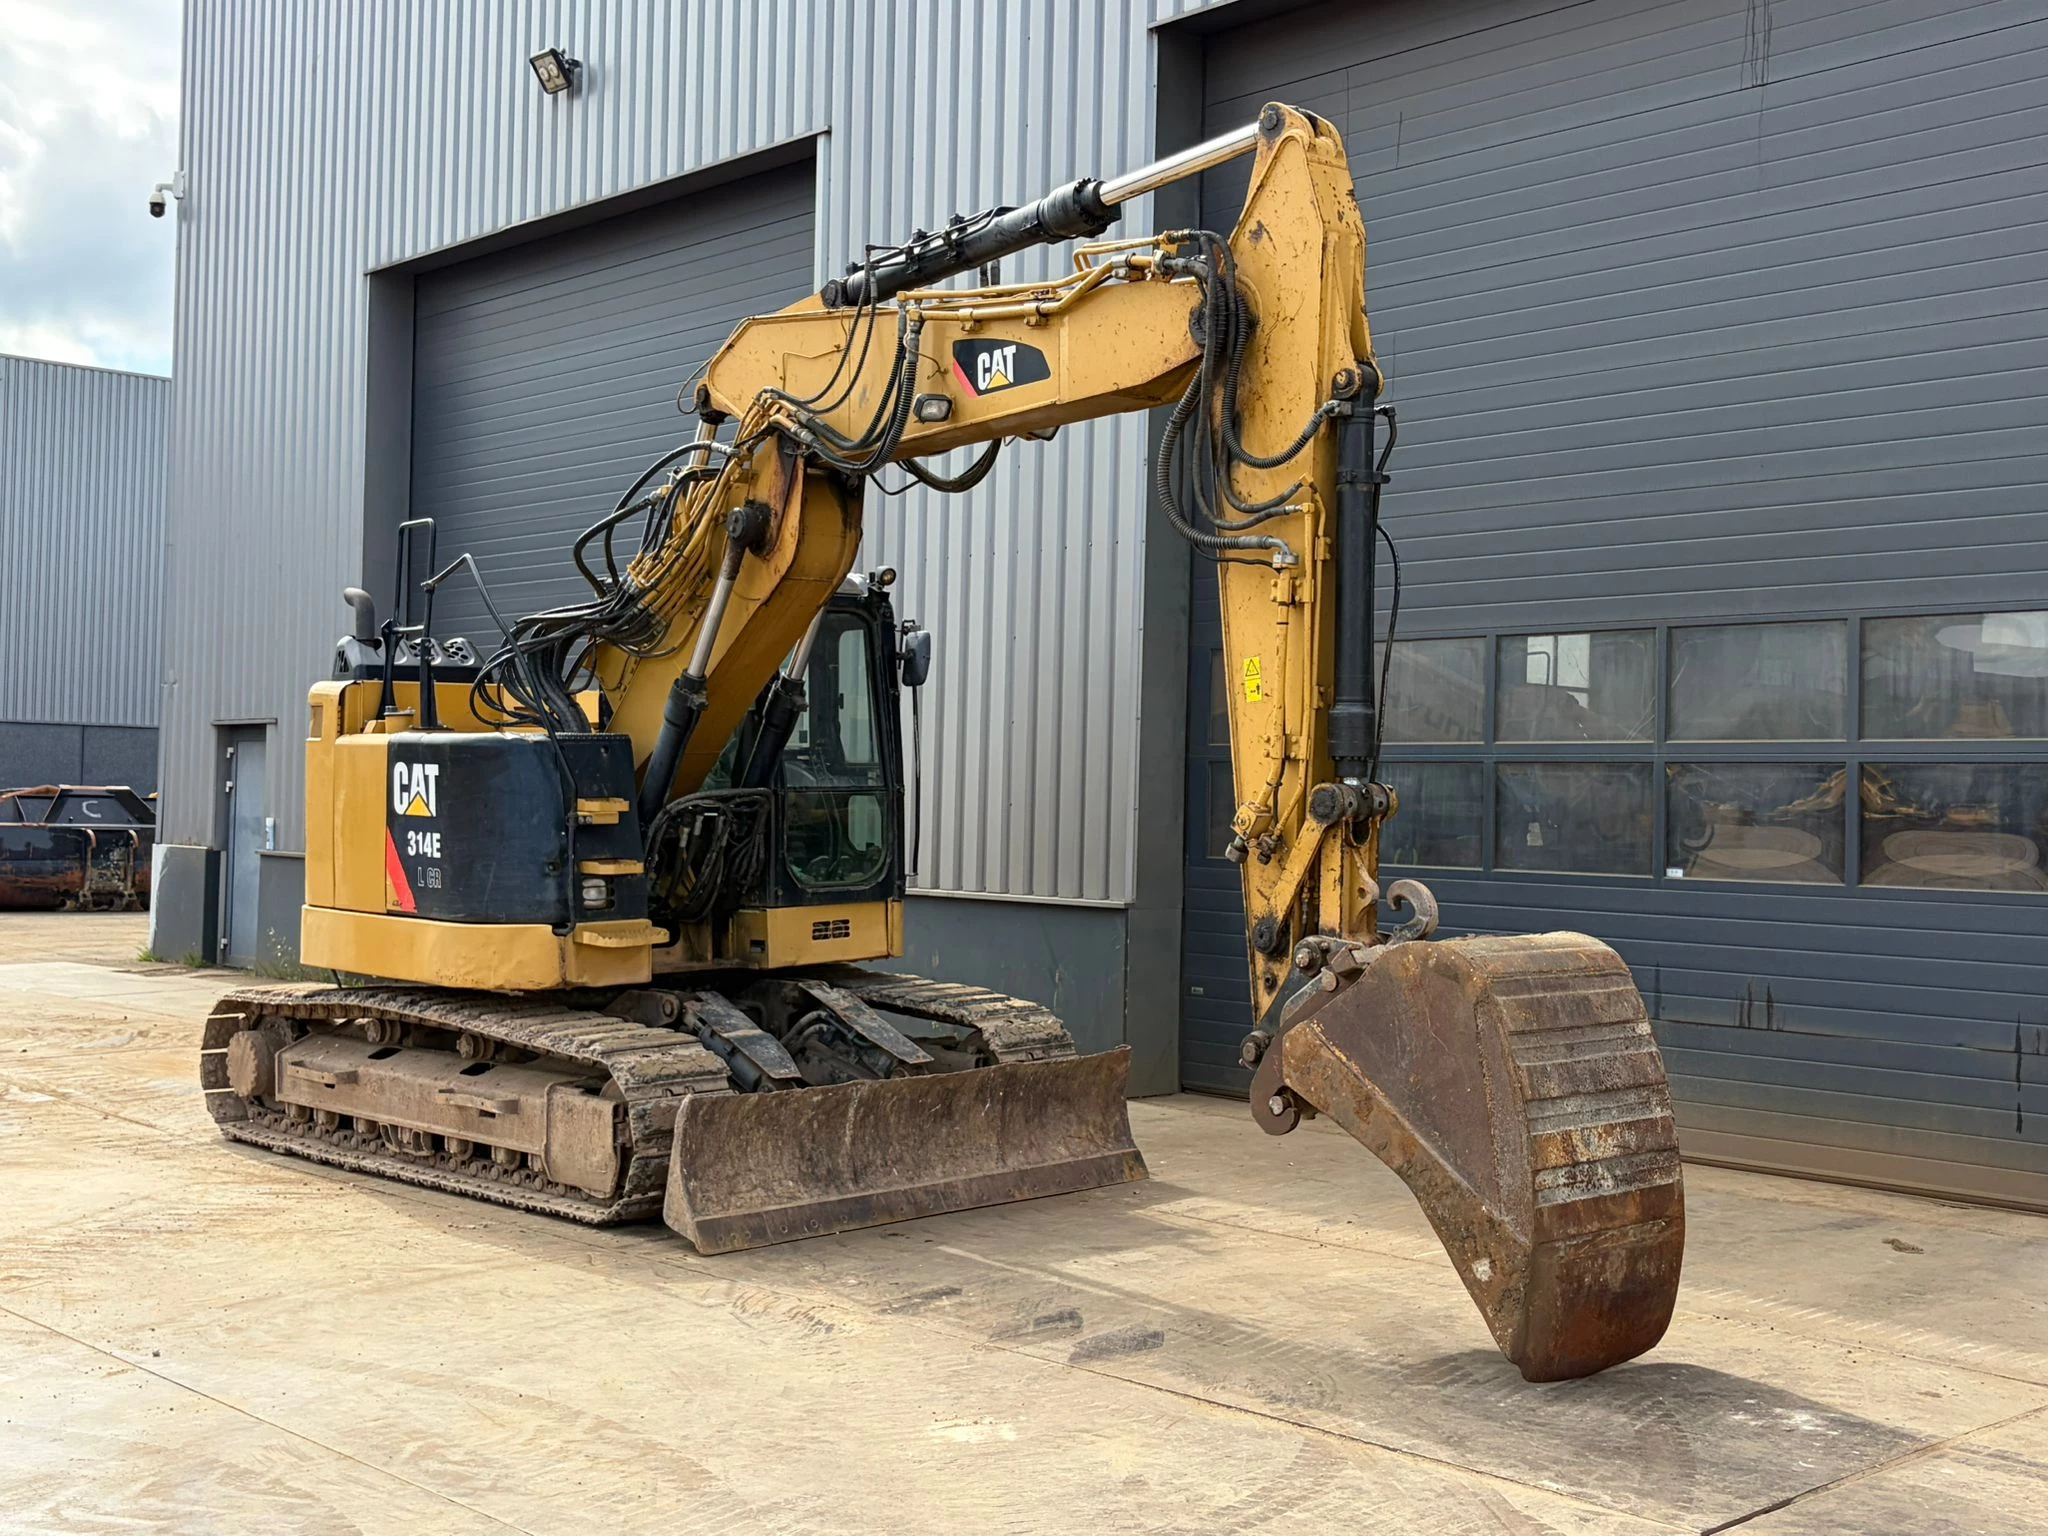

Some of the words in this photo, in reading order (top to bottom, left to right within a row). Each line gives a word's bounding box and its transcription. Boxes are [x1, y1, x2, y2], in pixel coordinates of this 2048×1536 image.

[977, 344, 1017, 391] CAT
[393, 761, 440, 818] CAT
[407, 830, 442, 859] 314E
[417, 866, 425, 887] L
[426, 867, 442, 889] CR
